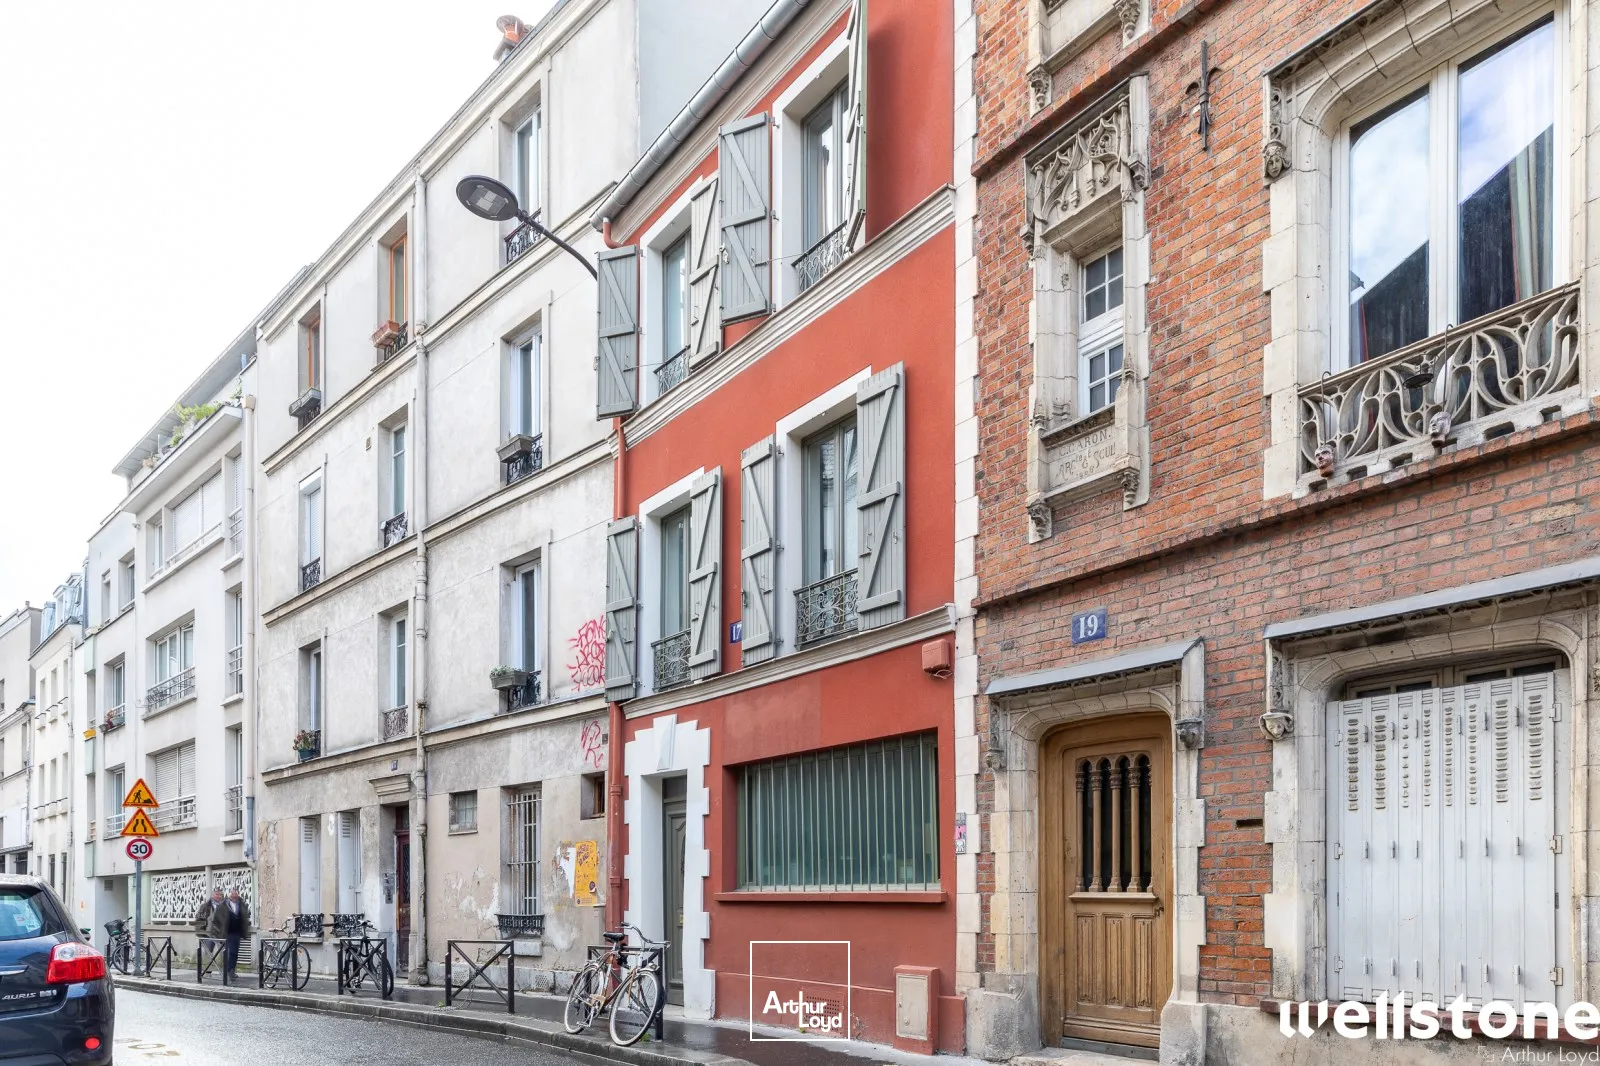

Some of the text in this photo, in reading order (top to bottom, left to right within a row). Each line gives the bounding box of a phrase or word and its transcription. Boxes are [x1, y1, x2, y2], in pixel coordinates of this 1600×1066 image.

[1079, 614, 1098, 639] 19
[132, 844, 148, 854] 30
[2, 992, 37, 1000] AURIS
